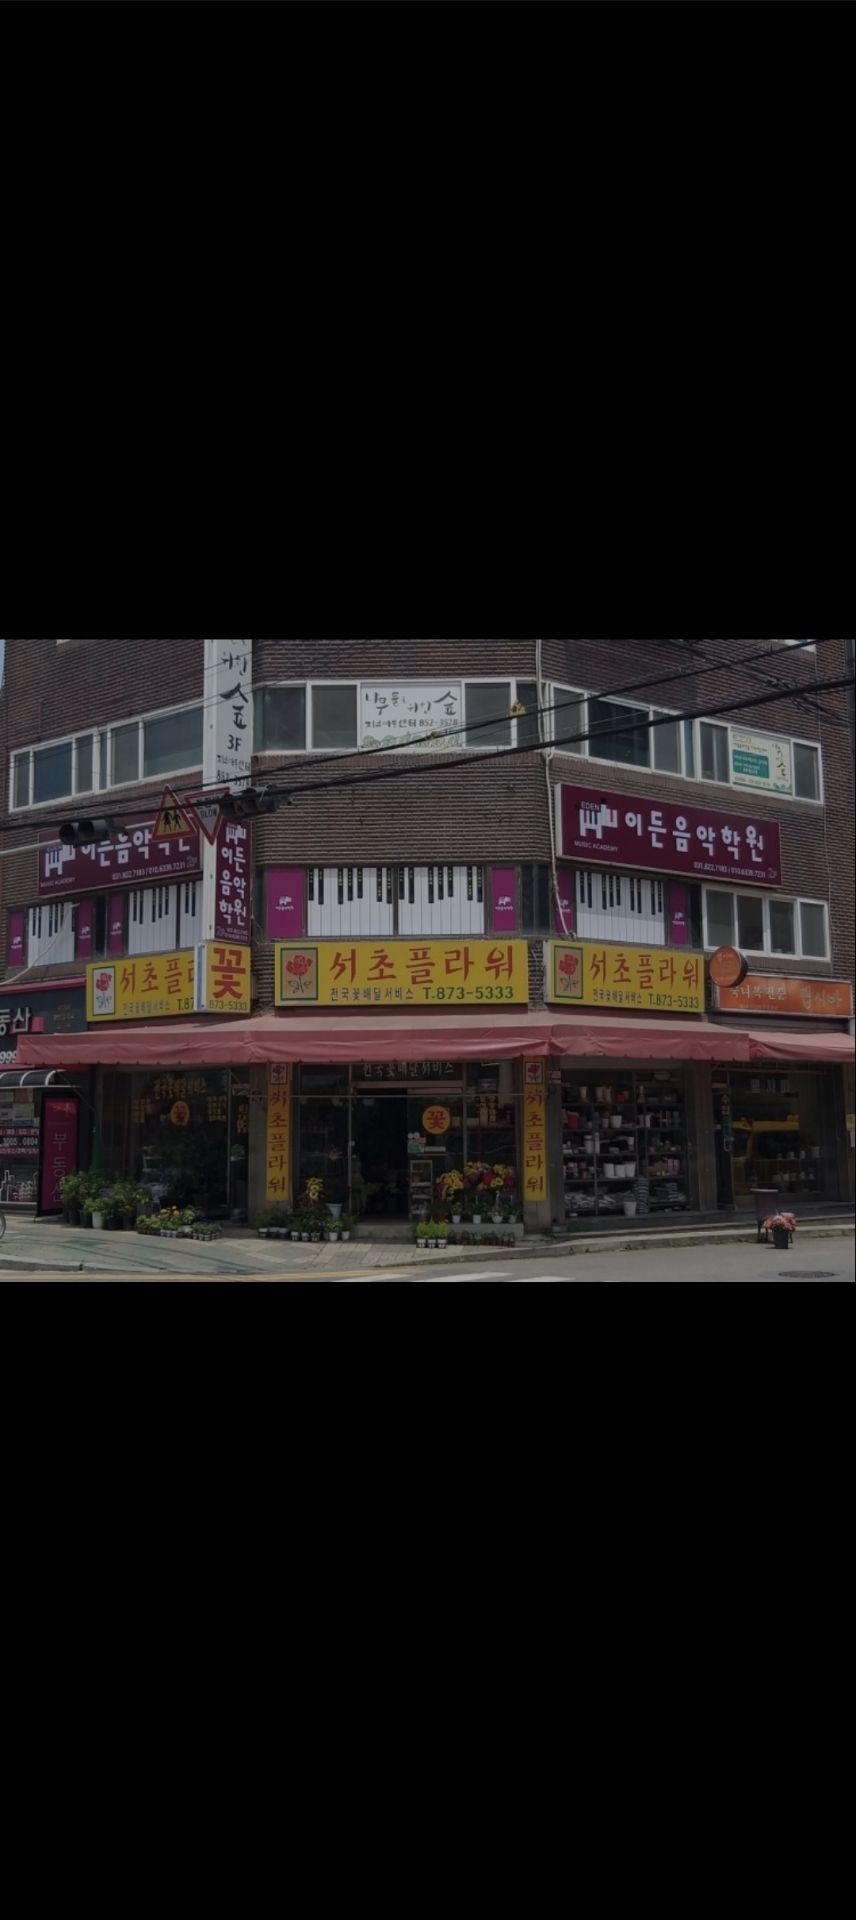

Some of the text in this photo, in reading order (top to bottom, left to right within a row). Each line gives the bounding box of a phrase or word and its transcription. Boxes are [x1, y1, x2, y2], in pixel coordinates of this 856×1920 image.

[227, 734, 243, 752] 3F
[581, 801, 600, 812] EDEN
[574, 840, 619, 853] MUSIC ACADEMY
[625, 811, 764, 863] 이든음악학원
[211, 947, 246, 1000] 꽃
[330, 945, 514, 986] 서초플라워
[590, 951, 699, 992] 서초플라워
[422, 986, 514, 1001] T.873-5333
[648, 993, 699, 1010] T.873-5333
[209, 999, 248, 1012] 873-5333
[427, 1110, 446, 1130] 꽃
[268, 1090, 287, 1193] 서초플라워
[526, 1090, 544, 1193] 서초플라워
